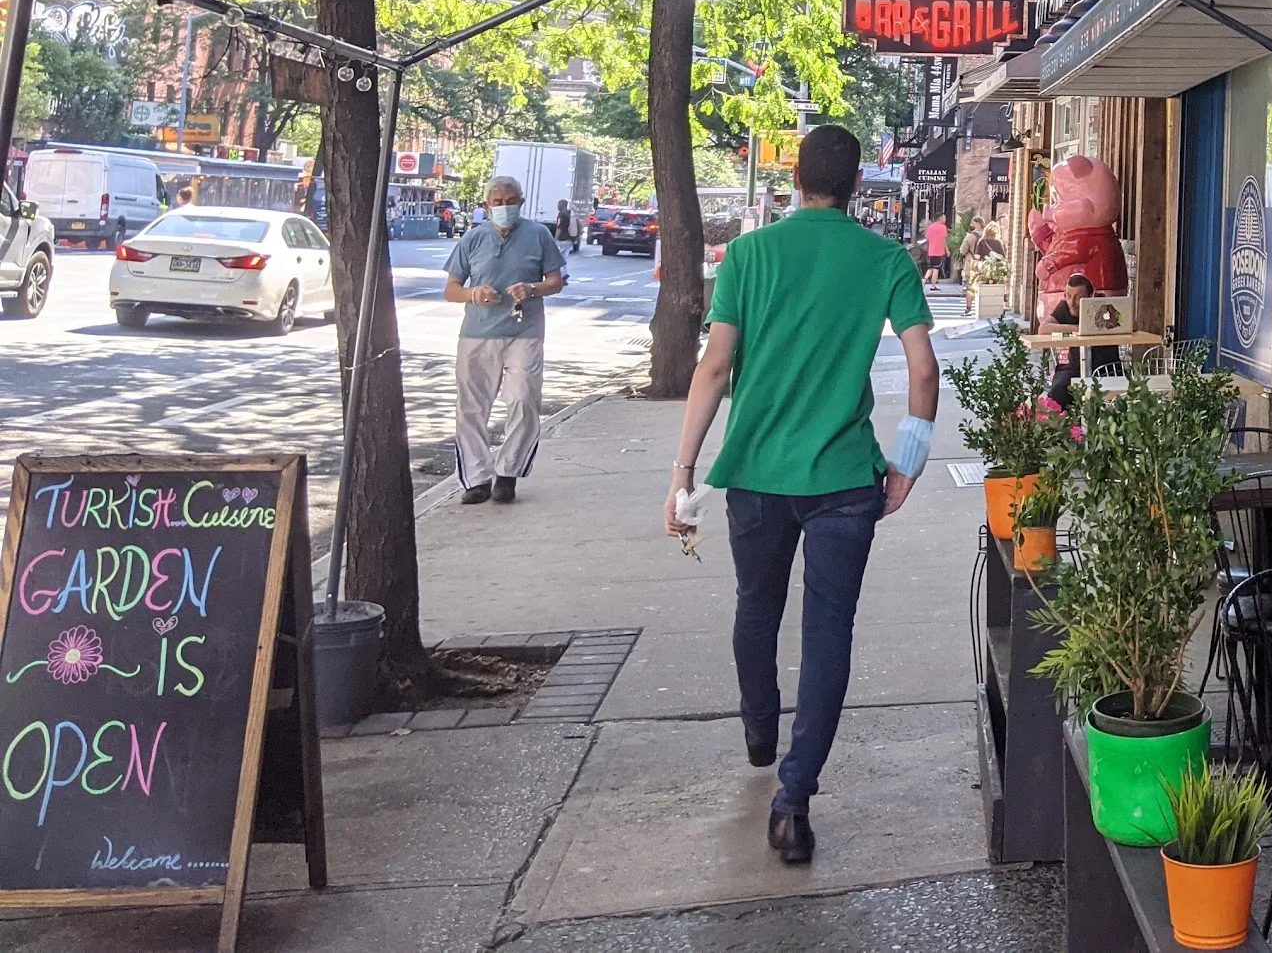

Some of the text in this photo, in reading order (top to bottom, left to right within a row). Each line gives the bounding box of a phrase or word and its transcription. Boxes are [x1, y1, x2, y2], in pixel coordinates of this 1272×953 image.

[1091, 15, 1107, 41] NINTH
[1108, 3, 1121, 27] AVE
[930, 78, 942, 93] Mia
[928, 100, 940, 120] Mama
[1232, 249, 1266, 284] POSEIDON
[1232, 275, 1265, 296] GREEK BAKERY
[19, 544, 223, 621] GARDEN
[157, 634, 206, 697] IS
[3, 720, 168, 827] OPEN
